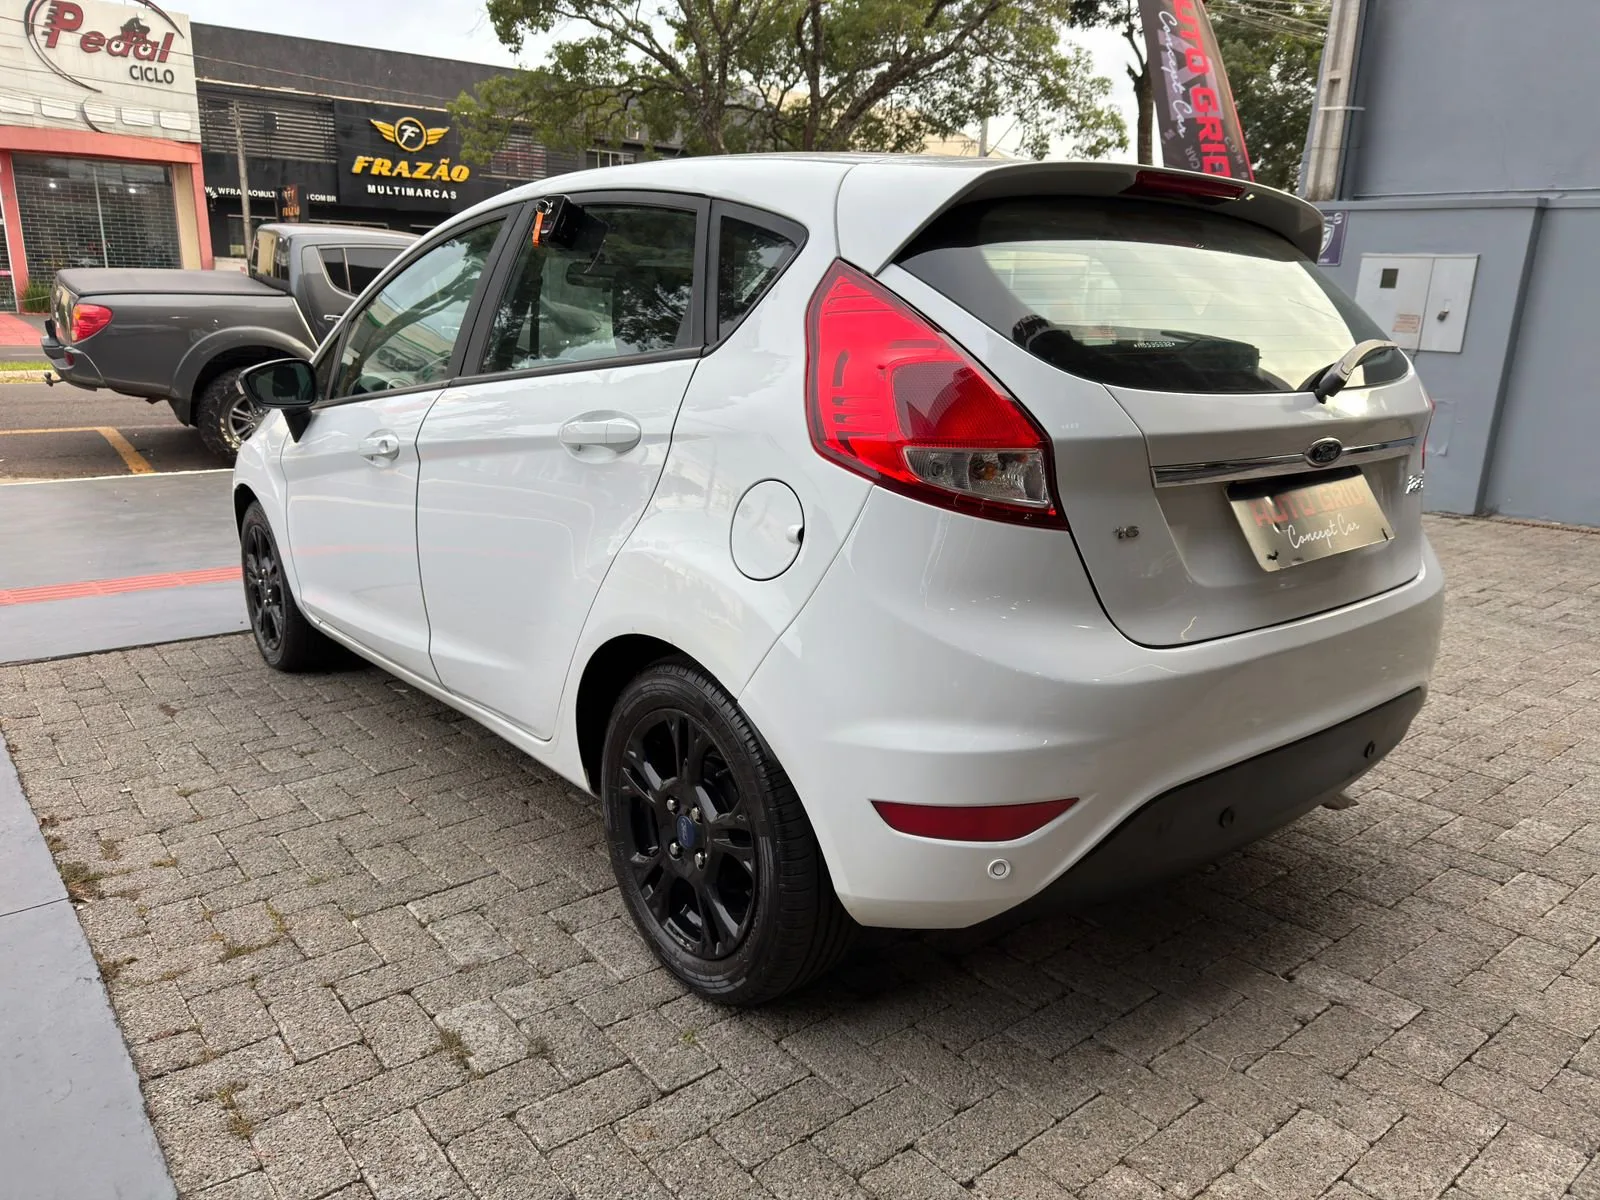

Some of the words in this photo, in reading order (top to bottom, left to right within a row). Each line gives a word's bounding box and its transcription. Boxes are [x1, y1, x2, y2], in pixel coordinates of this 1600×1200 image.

[42, 1, 175, 63] Pedal
[129, 64, 175, 84] CICLO
[1158, 11, 1186, 94] Concept
[1173, 100, 1192, 138] Car
[351, 155, 469, 182] FRAZÃO
[1185, 146, 1200, 169] CAR
[367, 184, 457, 199] MULTIMARCAS
[1248, 491, 1317, 528] AUTO
[1281, 519, 1337, 549] Concept
[1336, 513, 1360, 536] Car
